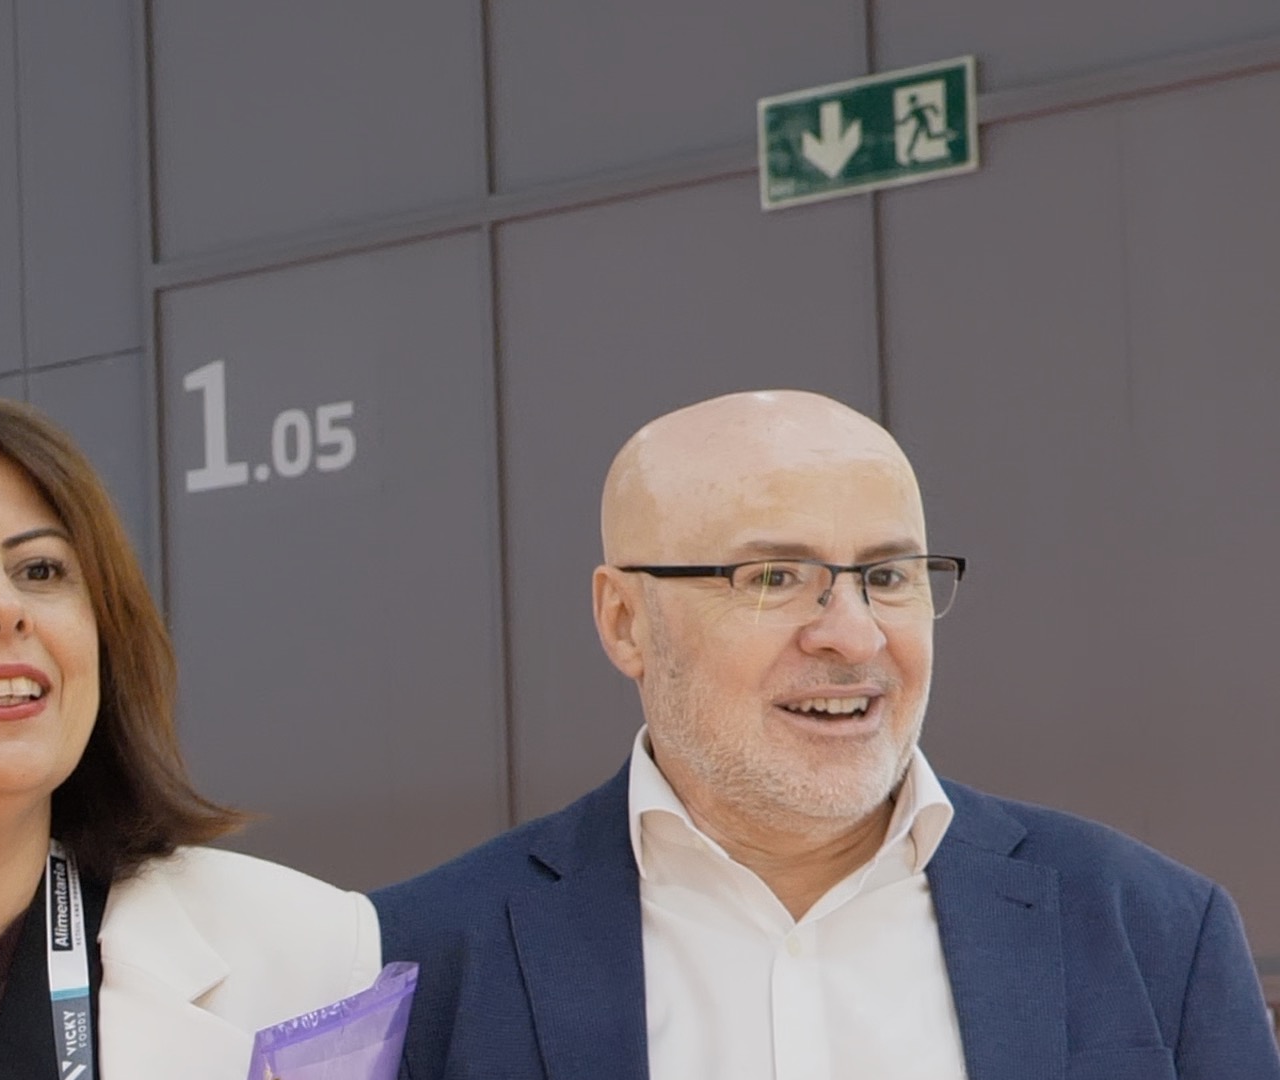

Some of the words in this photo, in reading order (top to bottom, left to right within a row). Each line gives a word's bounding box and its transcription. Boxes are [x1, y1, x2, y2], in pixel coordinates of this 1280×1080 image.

[183, 360, 357, 493] 1.05
[54, 862, 69, 947] Alimentaria
[63, 1010, 77, 1056] VICKY
[77, 1011, 87, 1049] FOODS
